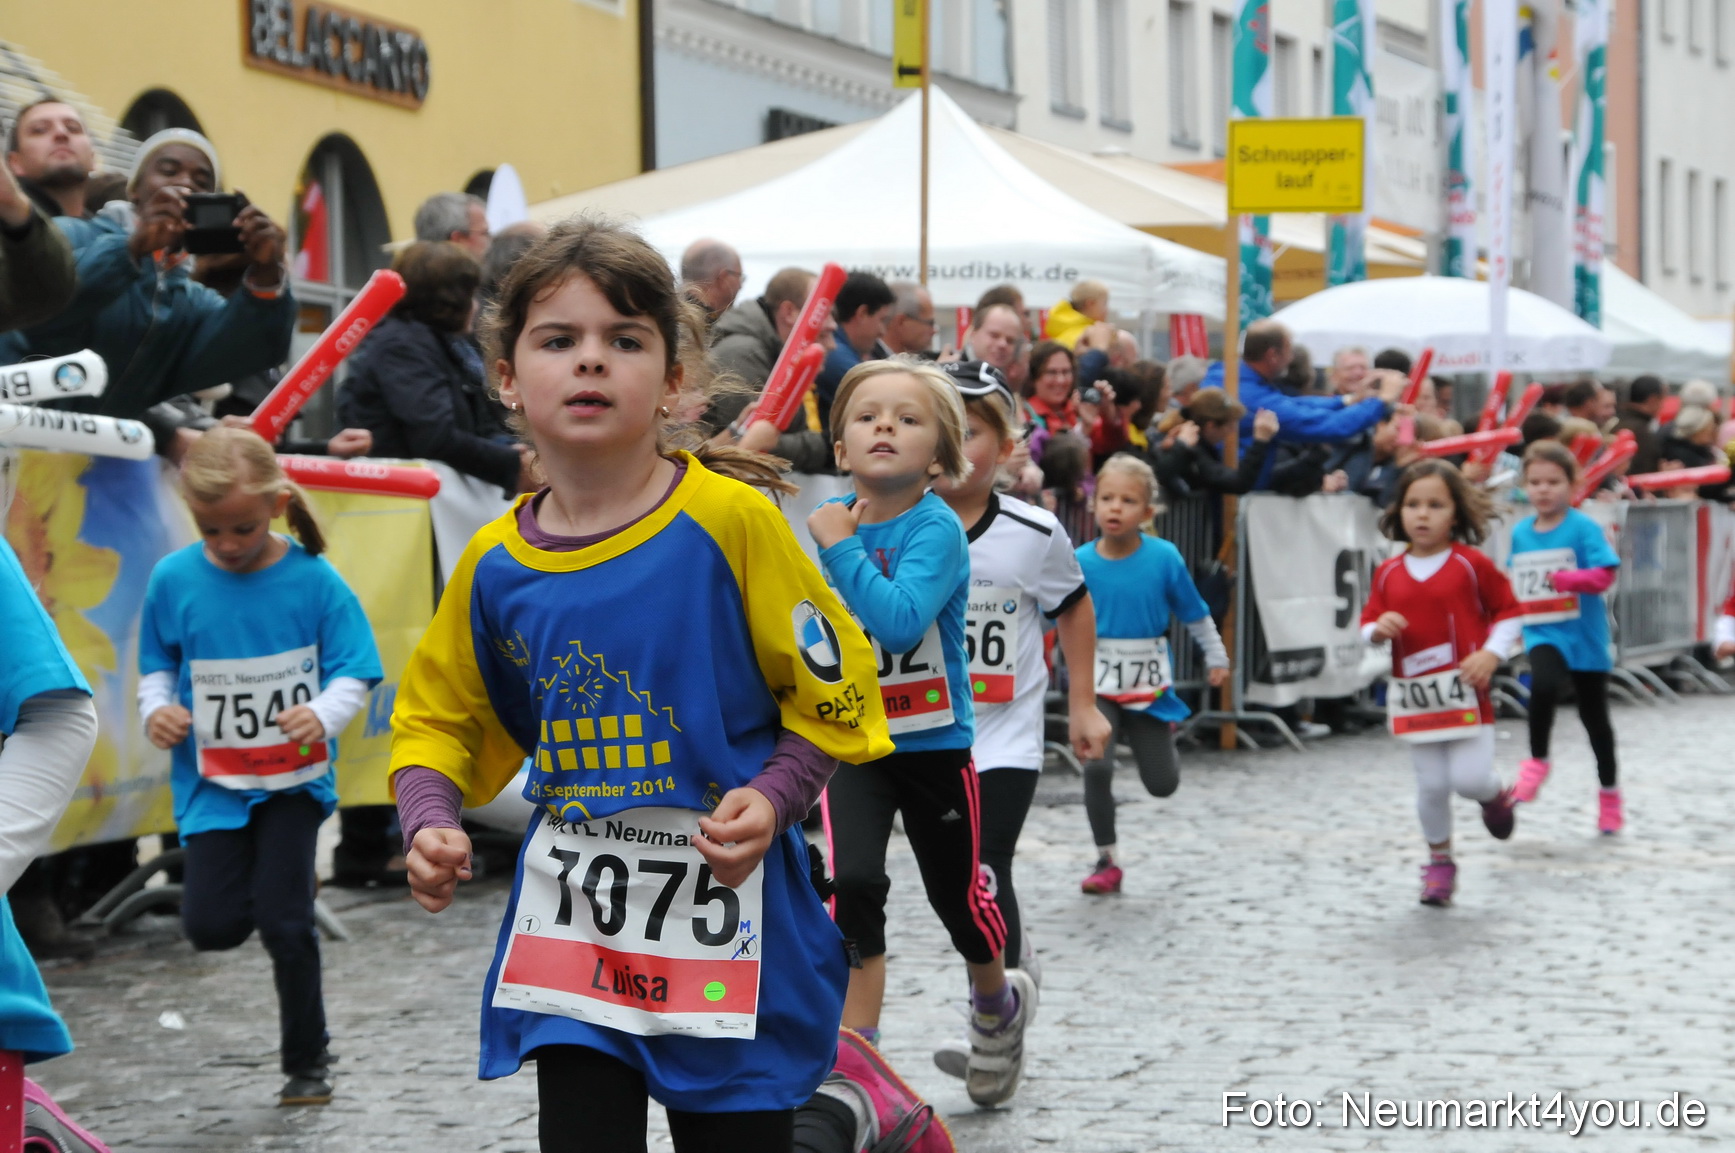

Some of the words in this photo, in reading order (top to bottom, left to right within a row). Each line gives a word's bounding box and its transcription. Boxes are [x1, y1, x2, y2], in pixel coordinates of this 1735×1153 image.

[1238, 144, 1356, 167] Schnupper-
[1276, 170, 1315, 189] lauf
[1518, 568, 1566, 594] 724
[966, 602, 997, 612] arkt
[235, 665, 298, 685] Neumarkt
[1097, 659, 1163, 690] 7178
[884, 691, 912, 713] na
[1398, 675, 1465, 709] 7014
[544, 782, 626, 800] September
[631, 775, 676, 797] 2014
[604, 820, 697, 848] Neuma
[547, 845, 741, 947] 7075
[590, 957, 669, 1003] Luisa
